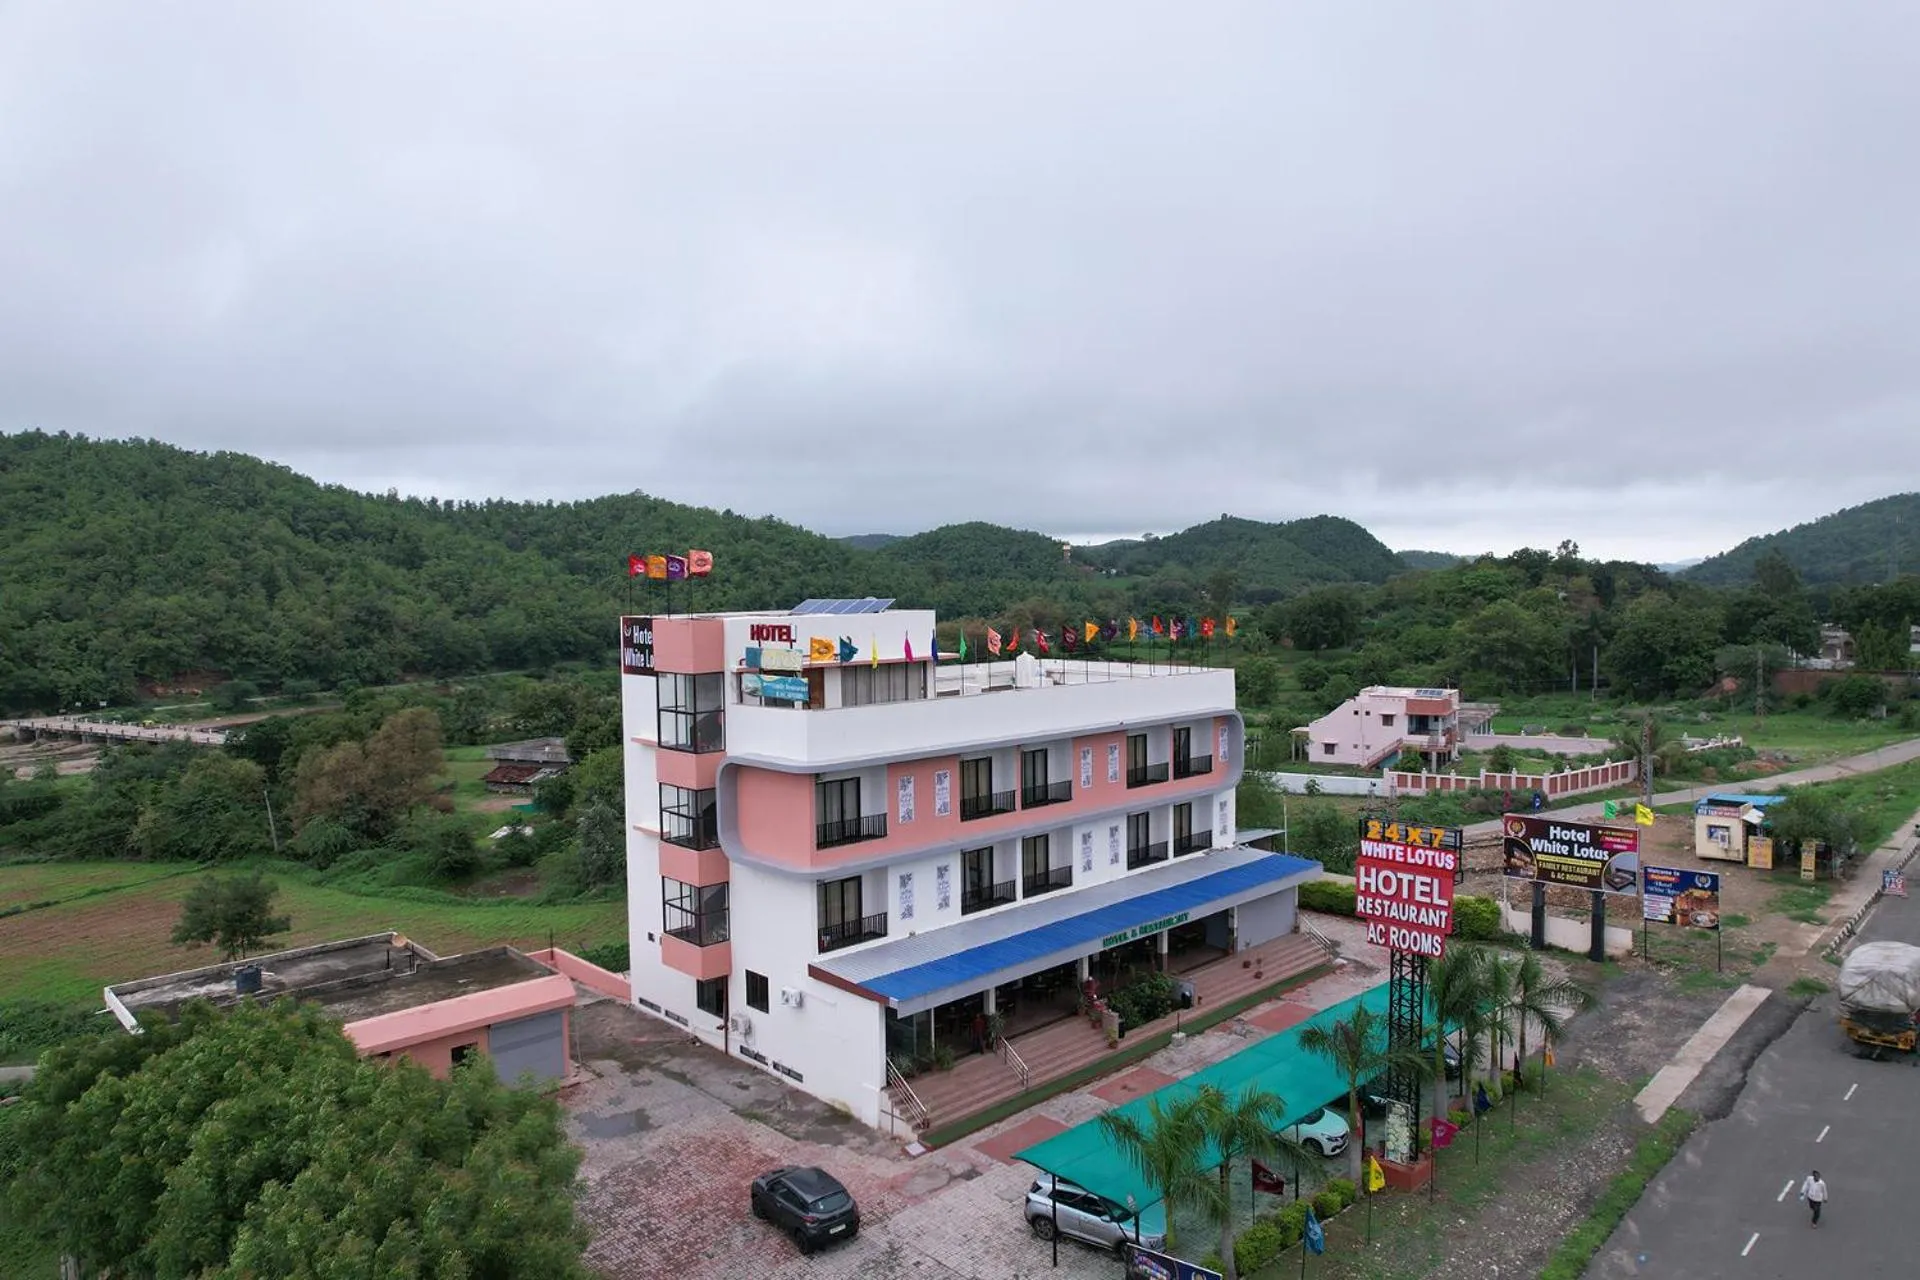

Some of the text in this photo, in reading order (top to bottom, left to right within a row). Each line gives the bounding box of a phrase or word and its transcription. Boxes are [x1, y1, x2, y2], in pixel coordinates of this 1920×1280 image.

[633, 625, 653, 645] Hote
[750, 624, 797, 643] HOTEL
[1549, 826, 1590, 843] Hotel
[1361, 840, 1454, 870] WHITE LOTUS
[1530, 838, 1609, 860] White Lotus
[1360, 866, 1449, 906] HOTEL
[1358, 895, 1448, 929] RESTAURANT
[1367, 922, 1441, 957] AC ROOMS
